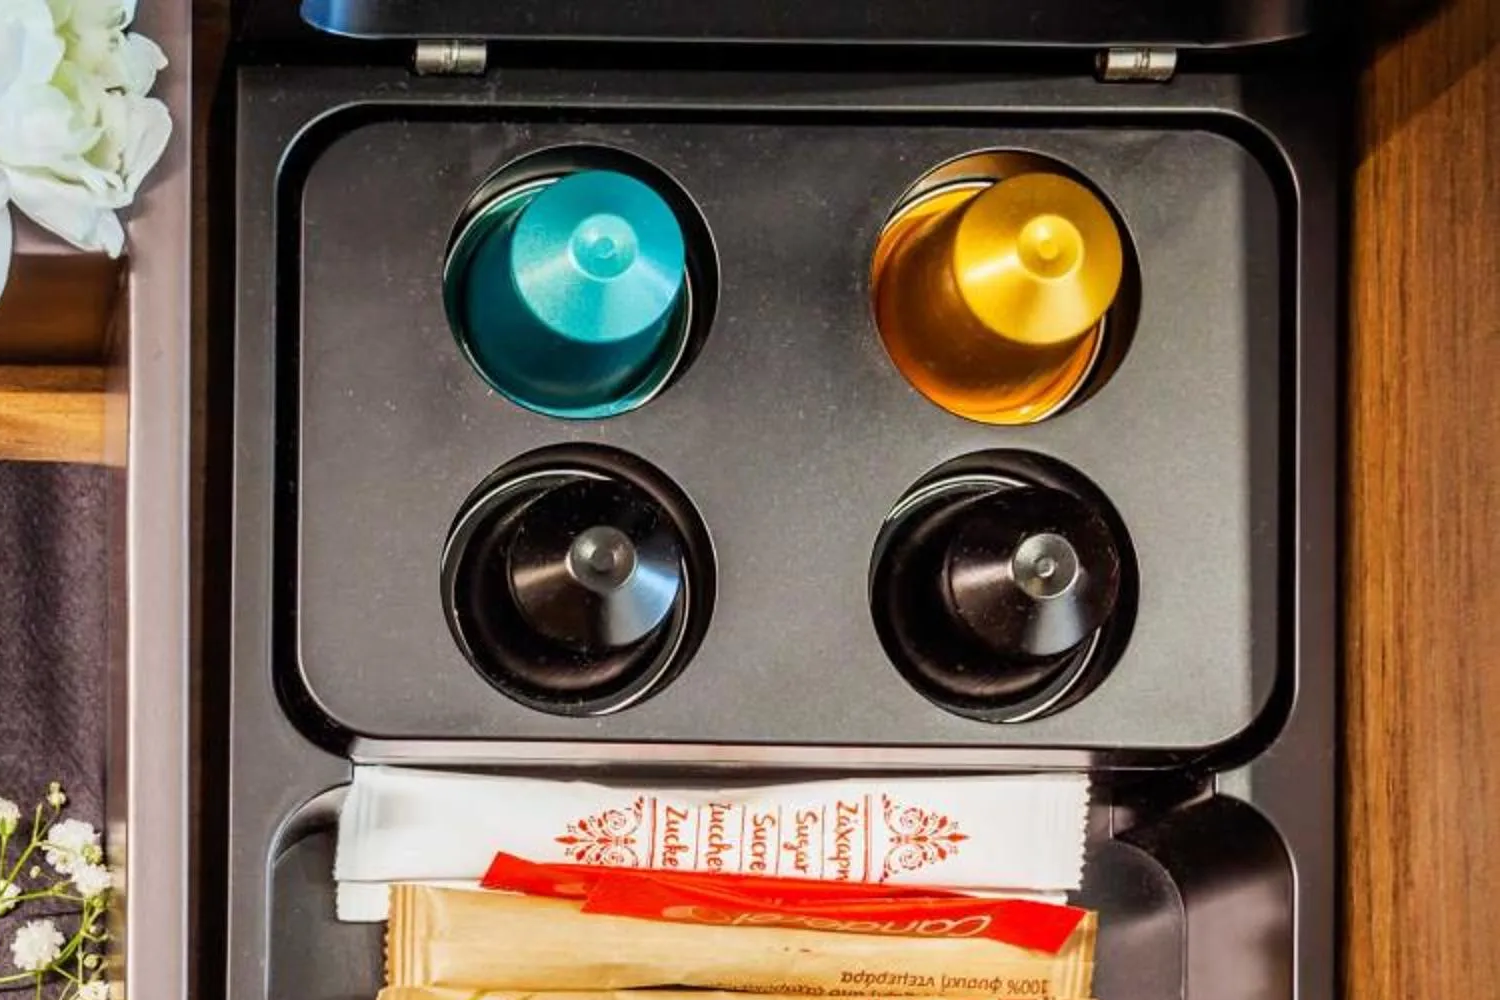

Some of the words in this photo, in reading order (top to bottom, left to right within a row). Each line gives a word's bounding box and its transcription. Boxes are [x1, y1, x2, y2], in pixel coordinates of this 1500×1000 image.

[662, 805, 689, 868] Zucke
[750, 813, 776, 871] Sucre
[783, 810, 818, 874] Sugar
[840, 969, 935, 988] ντεμεράρα
[940, 973, 1001, 993] φυσική
[1007, 979, 1049, 995] 100%
